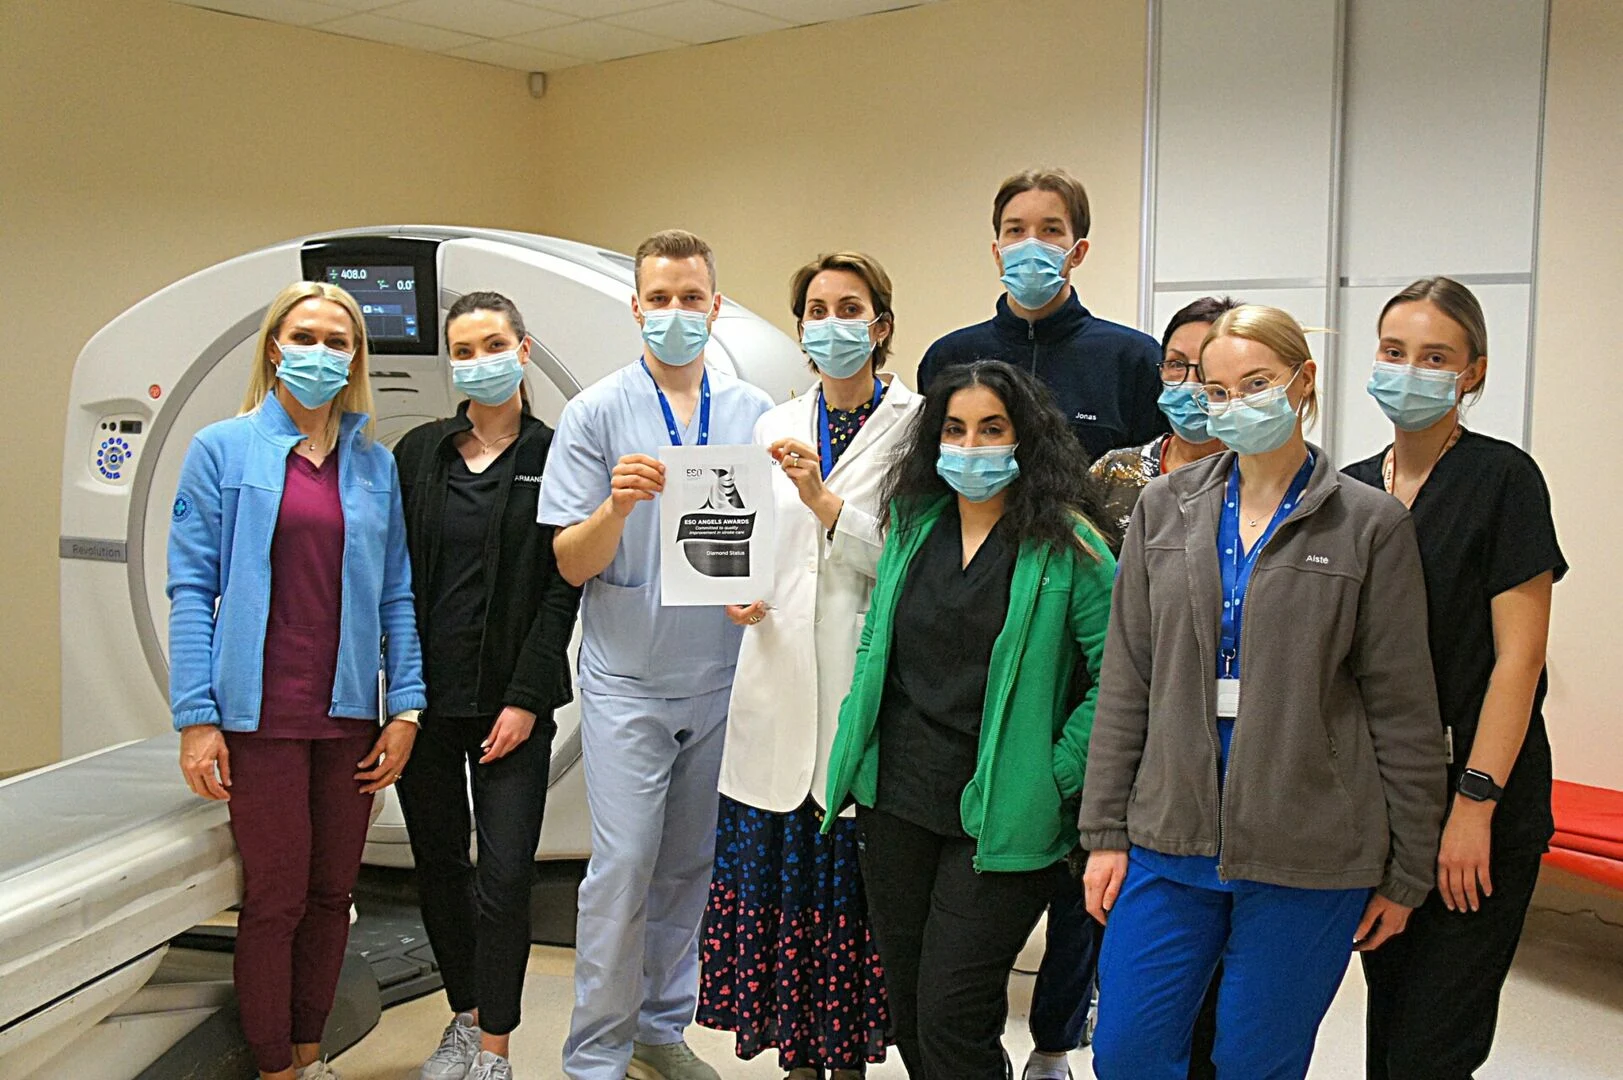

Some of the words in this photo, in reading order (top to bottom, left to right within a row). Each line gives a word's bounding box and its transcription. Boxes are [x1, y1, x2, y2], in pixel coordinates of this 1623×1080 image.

[341, 269, 367, 279] 408.0
[1075, 411, 1097, 421] Jonas
[686, 468, 703, 477] ESO
[72, 544, 121, 557] Revolution
